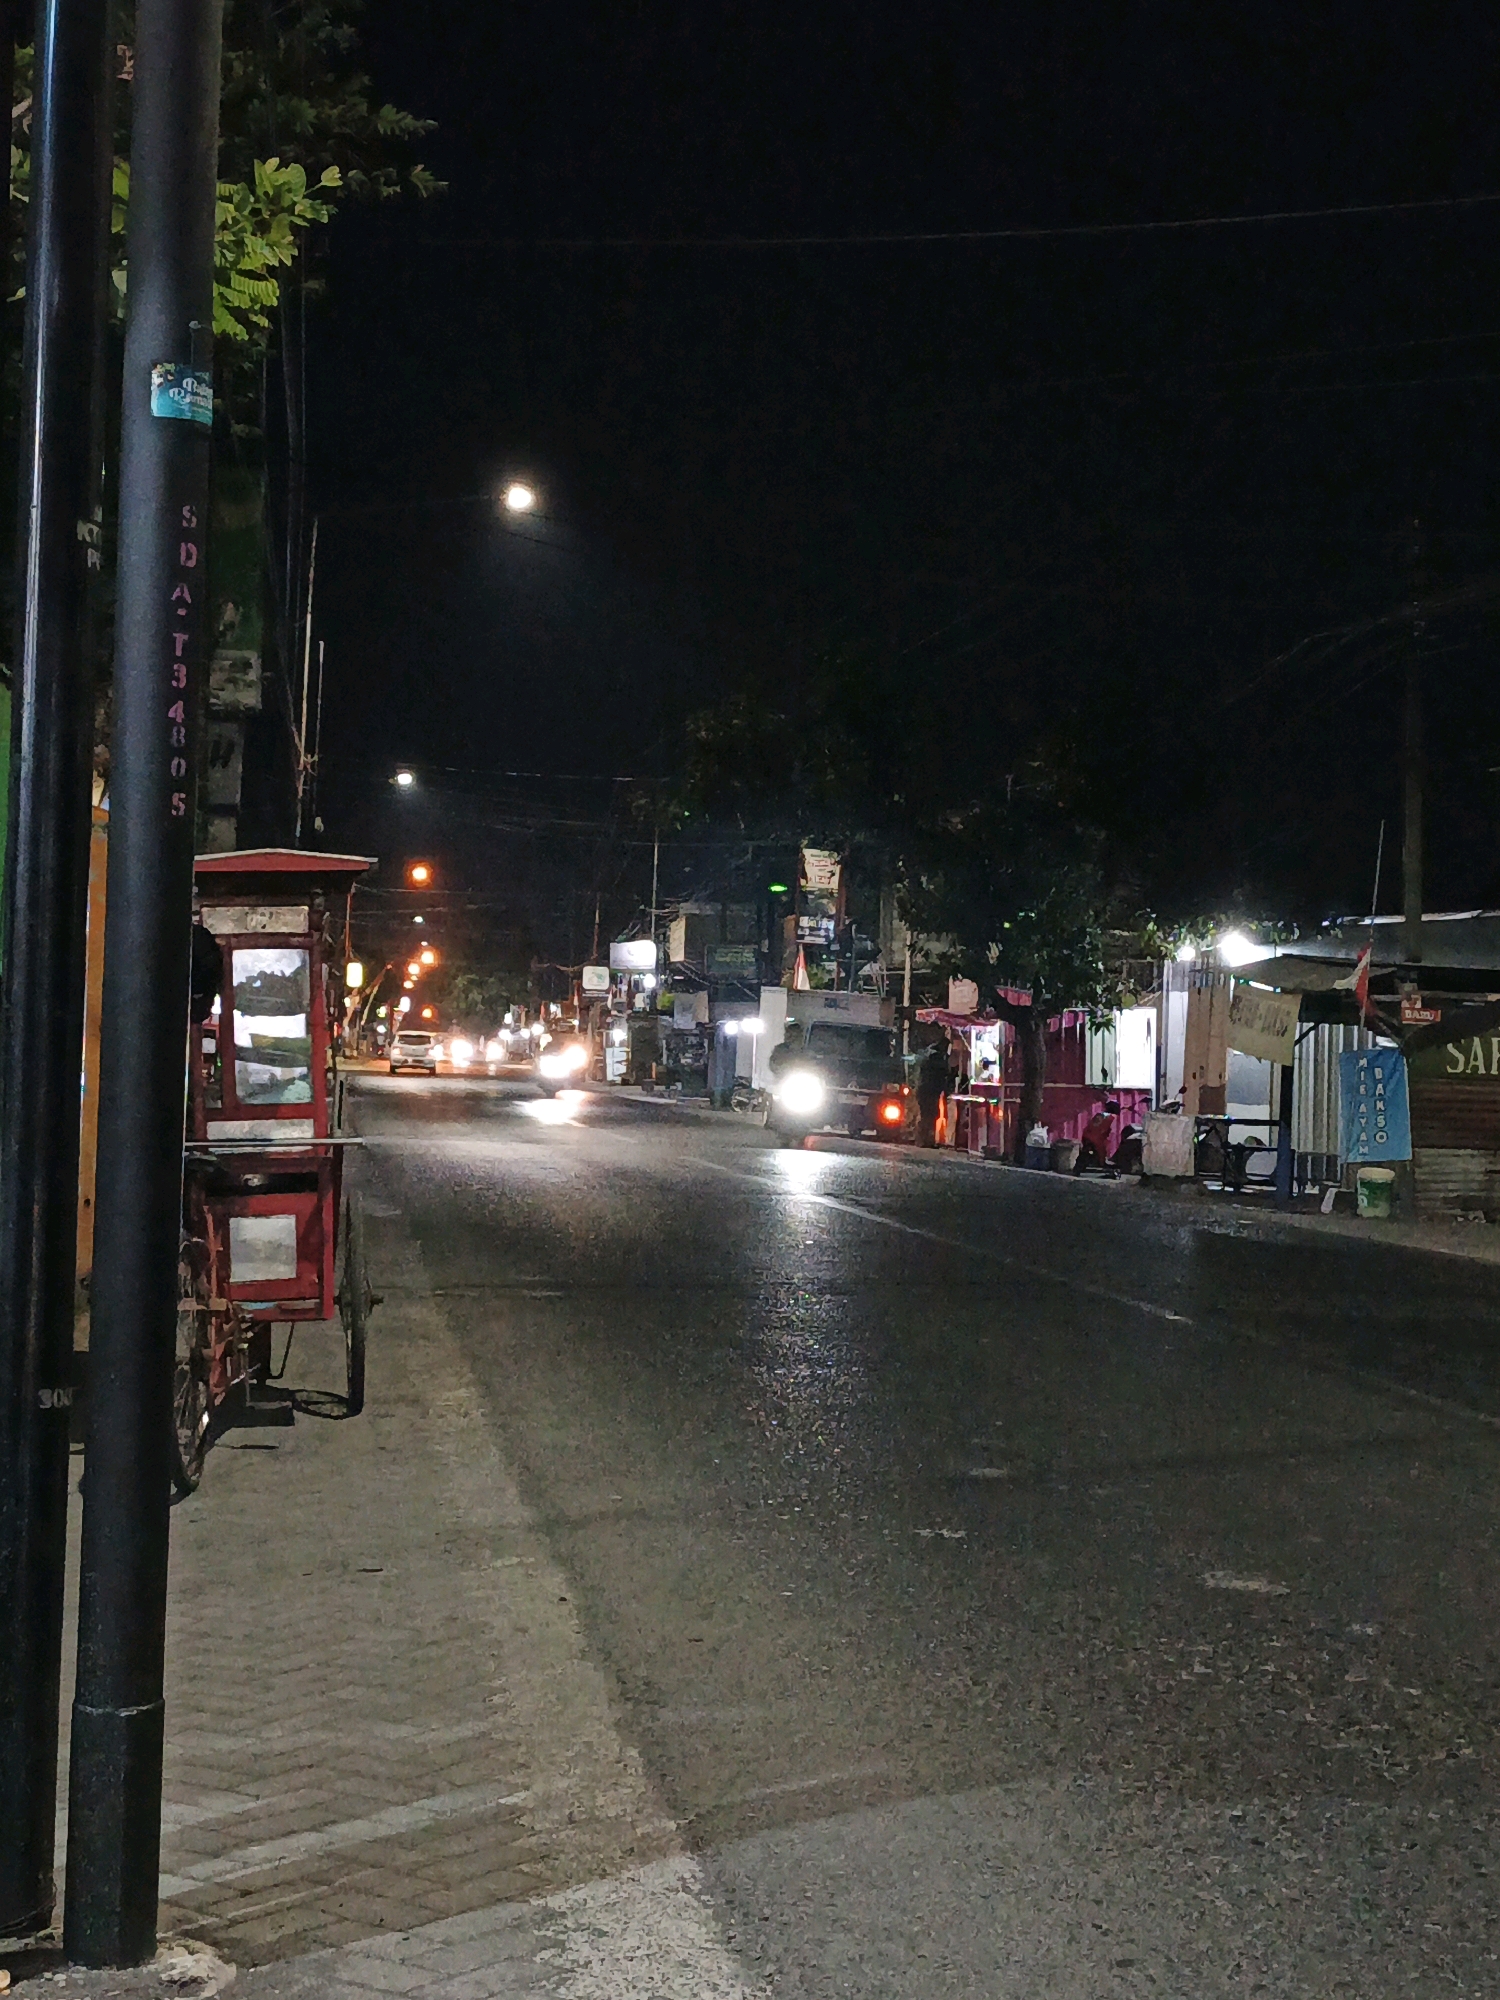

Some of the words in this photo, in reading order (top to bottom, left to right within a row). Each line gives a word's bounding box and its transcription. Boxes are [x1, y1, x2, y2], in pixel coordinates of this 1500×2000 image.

[1358, 1057, 1368, 1095] MIE
[1358, 1103, 1369, 1154] AYAM
[1374, 1067, 1388, 1144] BAKSO
